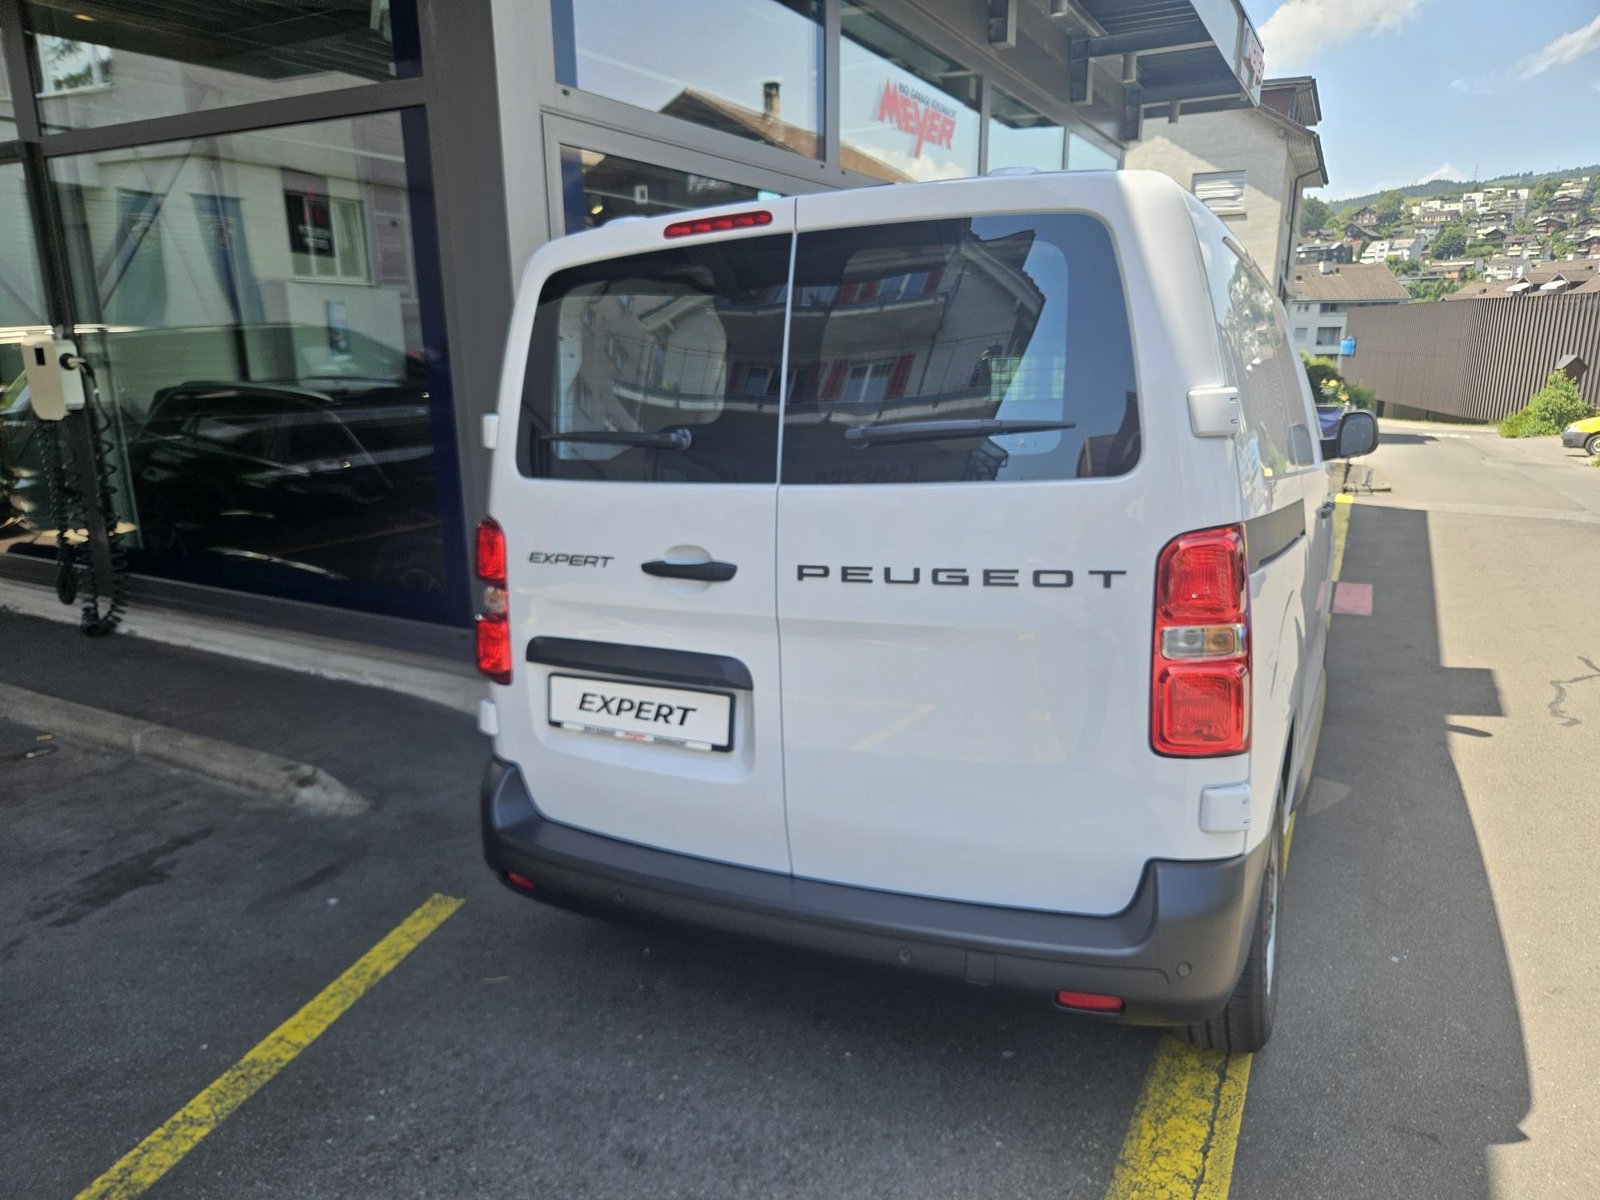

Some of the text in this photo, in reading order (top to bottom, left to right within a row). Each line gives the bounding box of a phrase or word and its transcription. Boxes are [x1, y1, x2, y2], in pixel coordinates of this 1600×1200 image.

[878, 79, 957, 159] MEYER
[528, 551, 615, 569] EXPERT
[796, 564, 1127, 589] PEUGEOT
[578, 692, 698, 727] EXPERT
